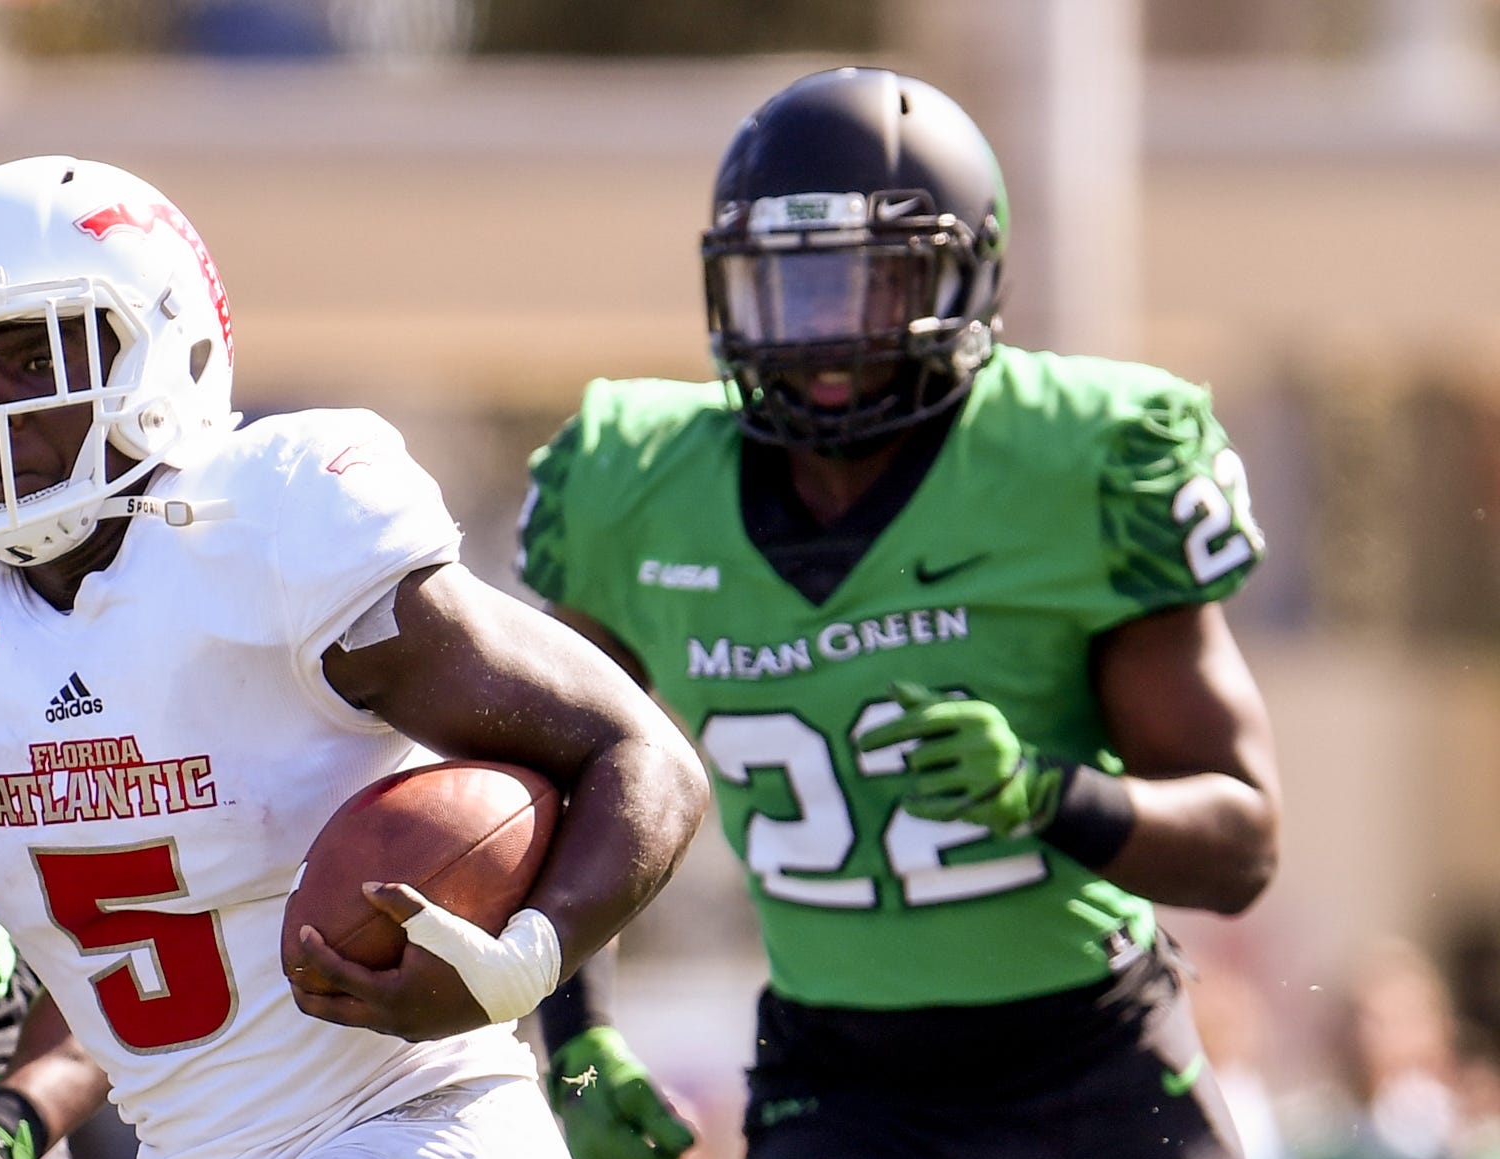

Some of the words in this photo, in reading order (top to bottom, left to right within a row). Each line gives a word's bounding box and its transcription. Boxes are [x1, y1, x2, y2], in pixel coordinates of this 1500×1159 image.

[28, 735, 146, 774] FLORIDA
[45, 698, 103, 724] adidas
[696, 682, 1052, 912] 22
[27, 835, 240, 1057] 5
